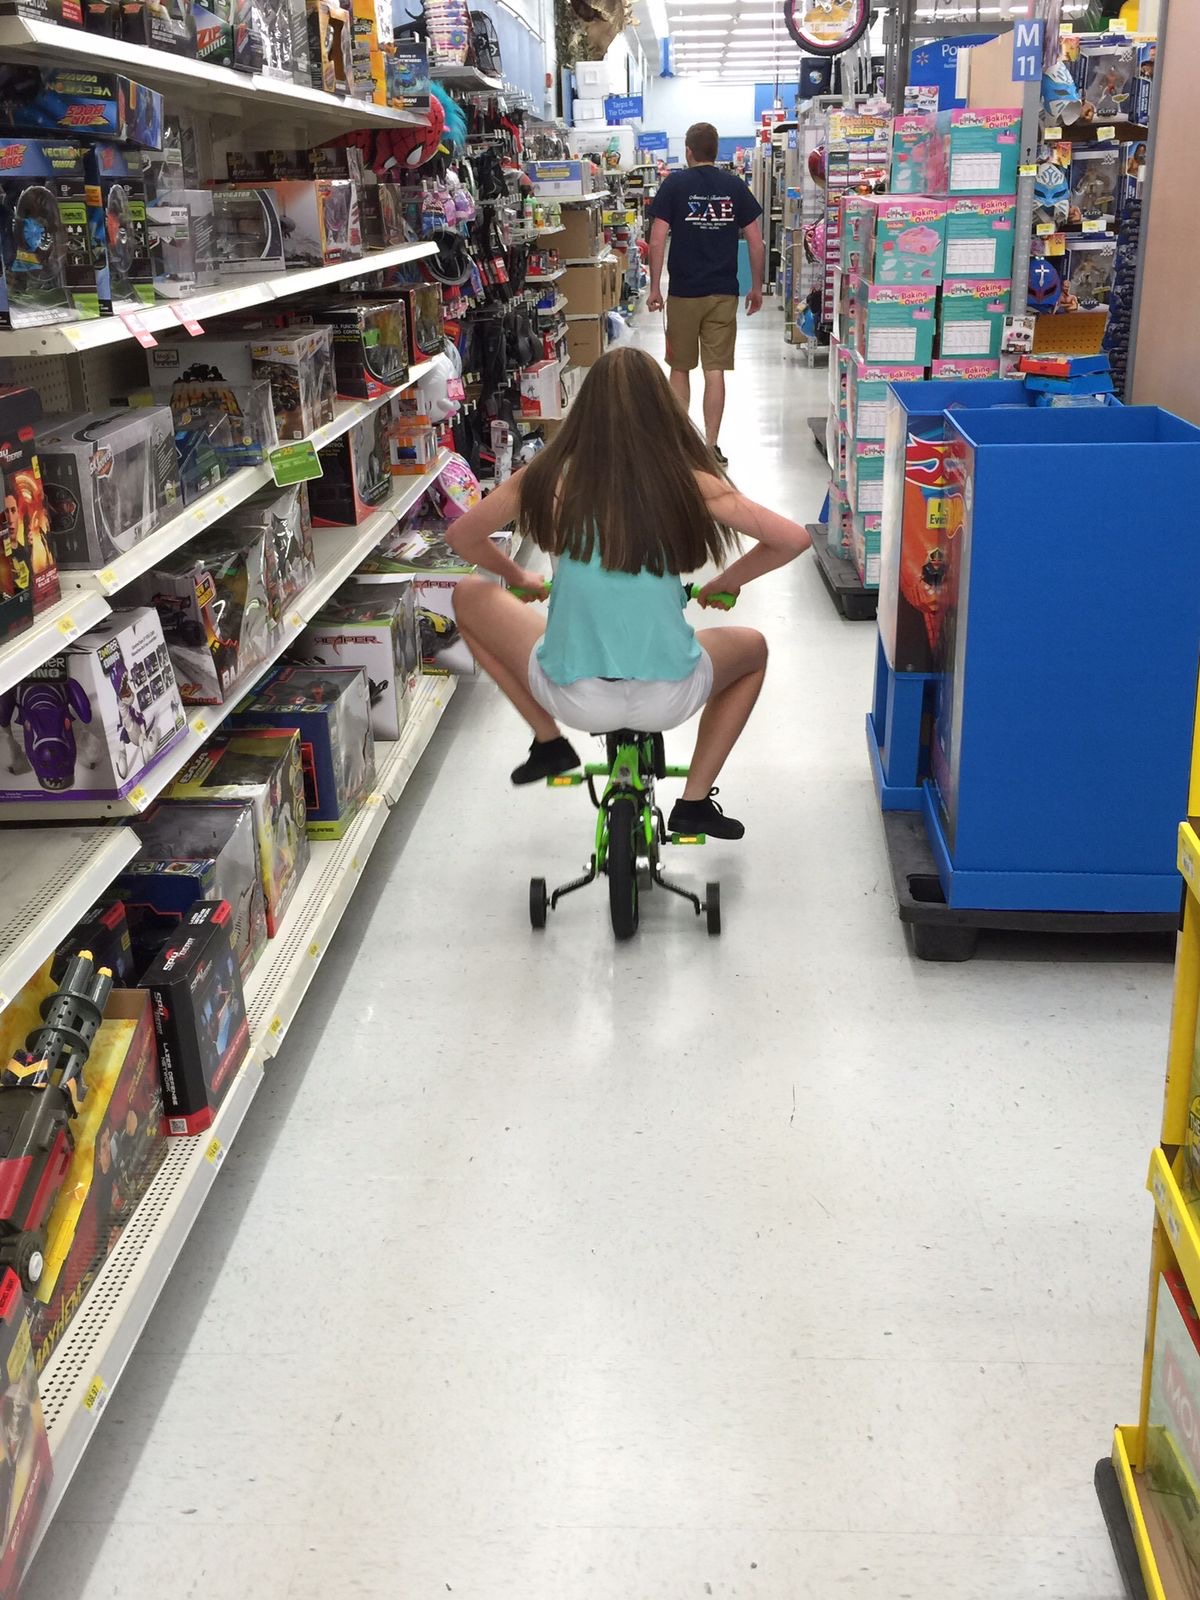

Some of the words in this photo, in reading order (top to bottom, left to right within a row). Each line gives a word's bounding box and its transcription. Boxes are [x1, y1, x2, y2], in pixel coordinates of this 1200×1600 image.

[1016, 24, 1039, 47] M
[1018, 57, 1035, 76] 11
[985, 114, 1012, 123] Baking
[980, 200, 1007, 209] Baking
[912, 209, 938, 218] Baking
[976, 284, 1002, 292] Baking
[901, 291, 928, 299] Baking
[964, 367, 990, 375] Baking
[163, 1042, 172, 1069] LAZER
[168, 1071, 178, 1106] DEFENSE
